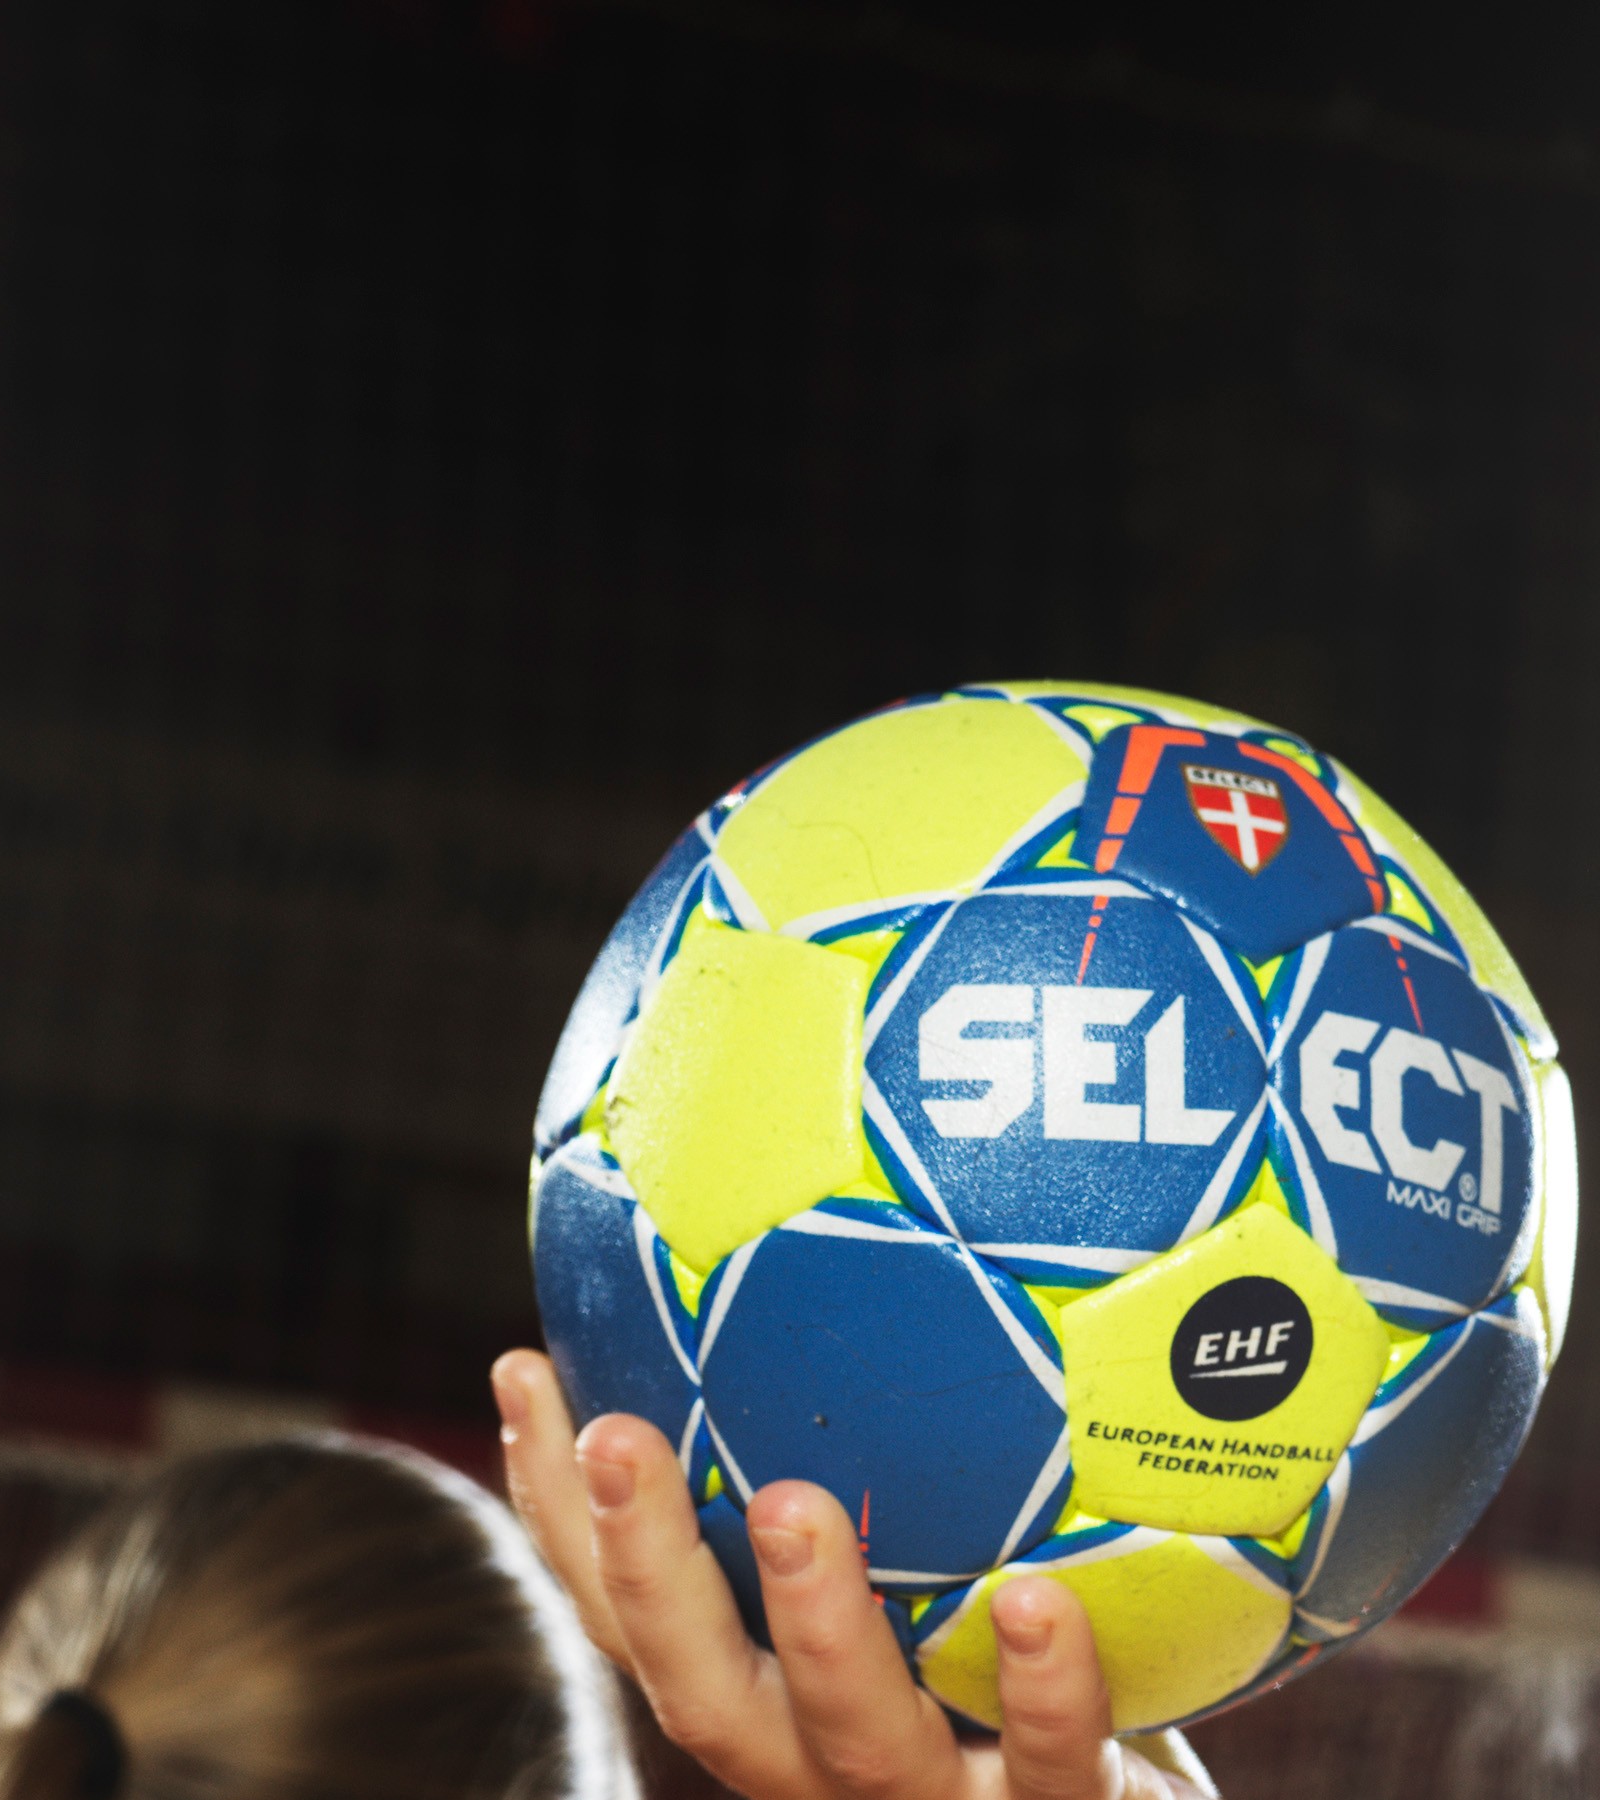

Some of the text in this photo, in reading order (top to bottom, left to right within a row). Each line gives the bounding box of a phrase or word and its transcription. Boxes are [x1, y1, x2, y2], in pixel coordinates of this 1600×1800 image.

[1386, 1180, 1451, 1220] MAXI
[1193, 1321, 1295, 1366] EHF
[1087, 1421, 1334, 1463] EUROPEAN HANDBALL
[1138, 1451, 1279, 1481] FEDERATION
